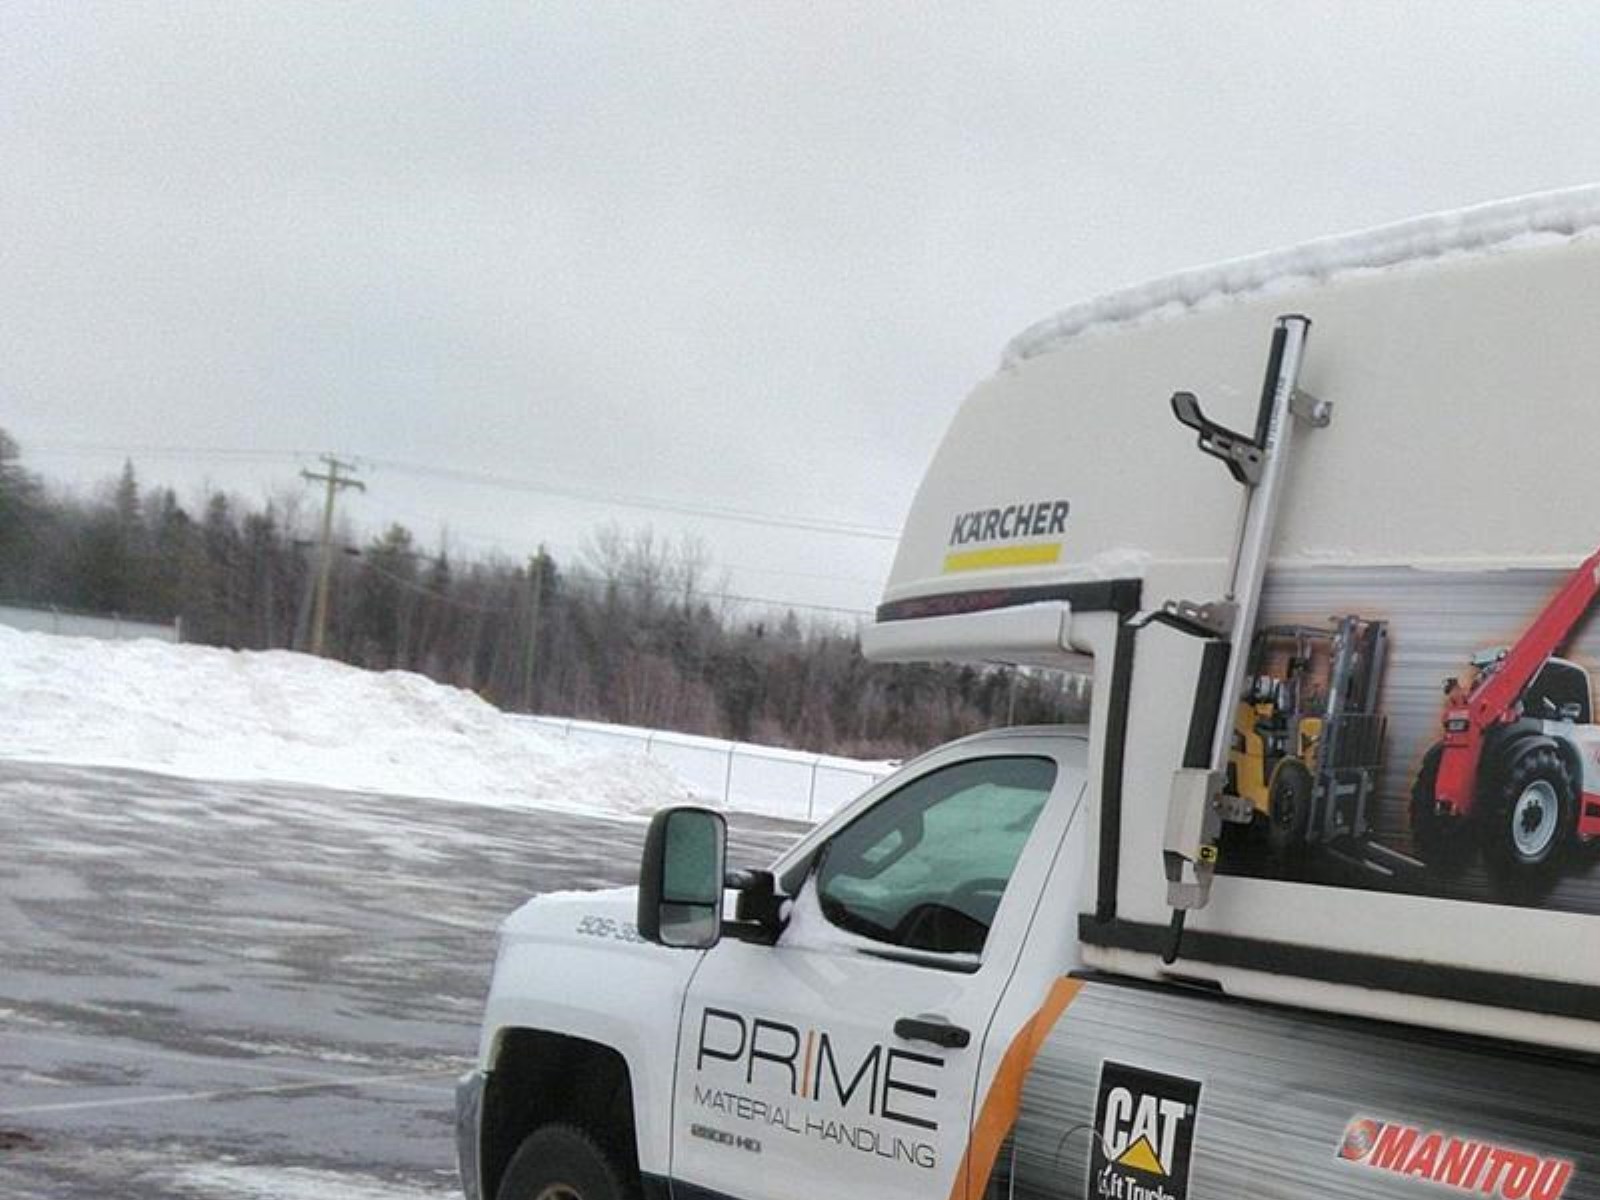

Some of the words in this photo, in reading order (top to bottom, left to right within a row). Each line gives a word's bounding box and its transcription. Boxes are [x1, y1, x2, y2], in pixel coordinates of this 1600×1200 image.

[697, 1006, 945, 1131] PRIME
[693, 1085, 801, 1134] MATERIAL
[805, 1114, 936, 1169] HANDLING
[1103, 1086, 1187, 1177] CAT
